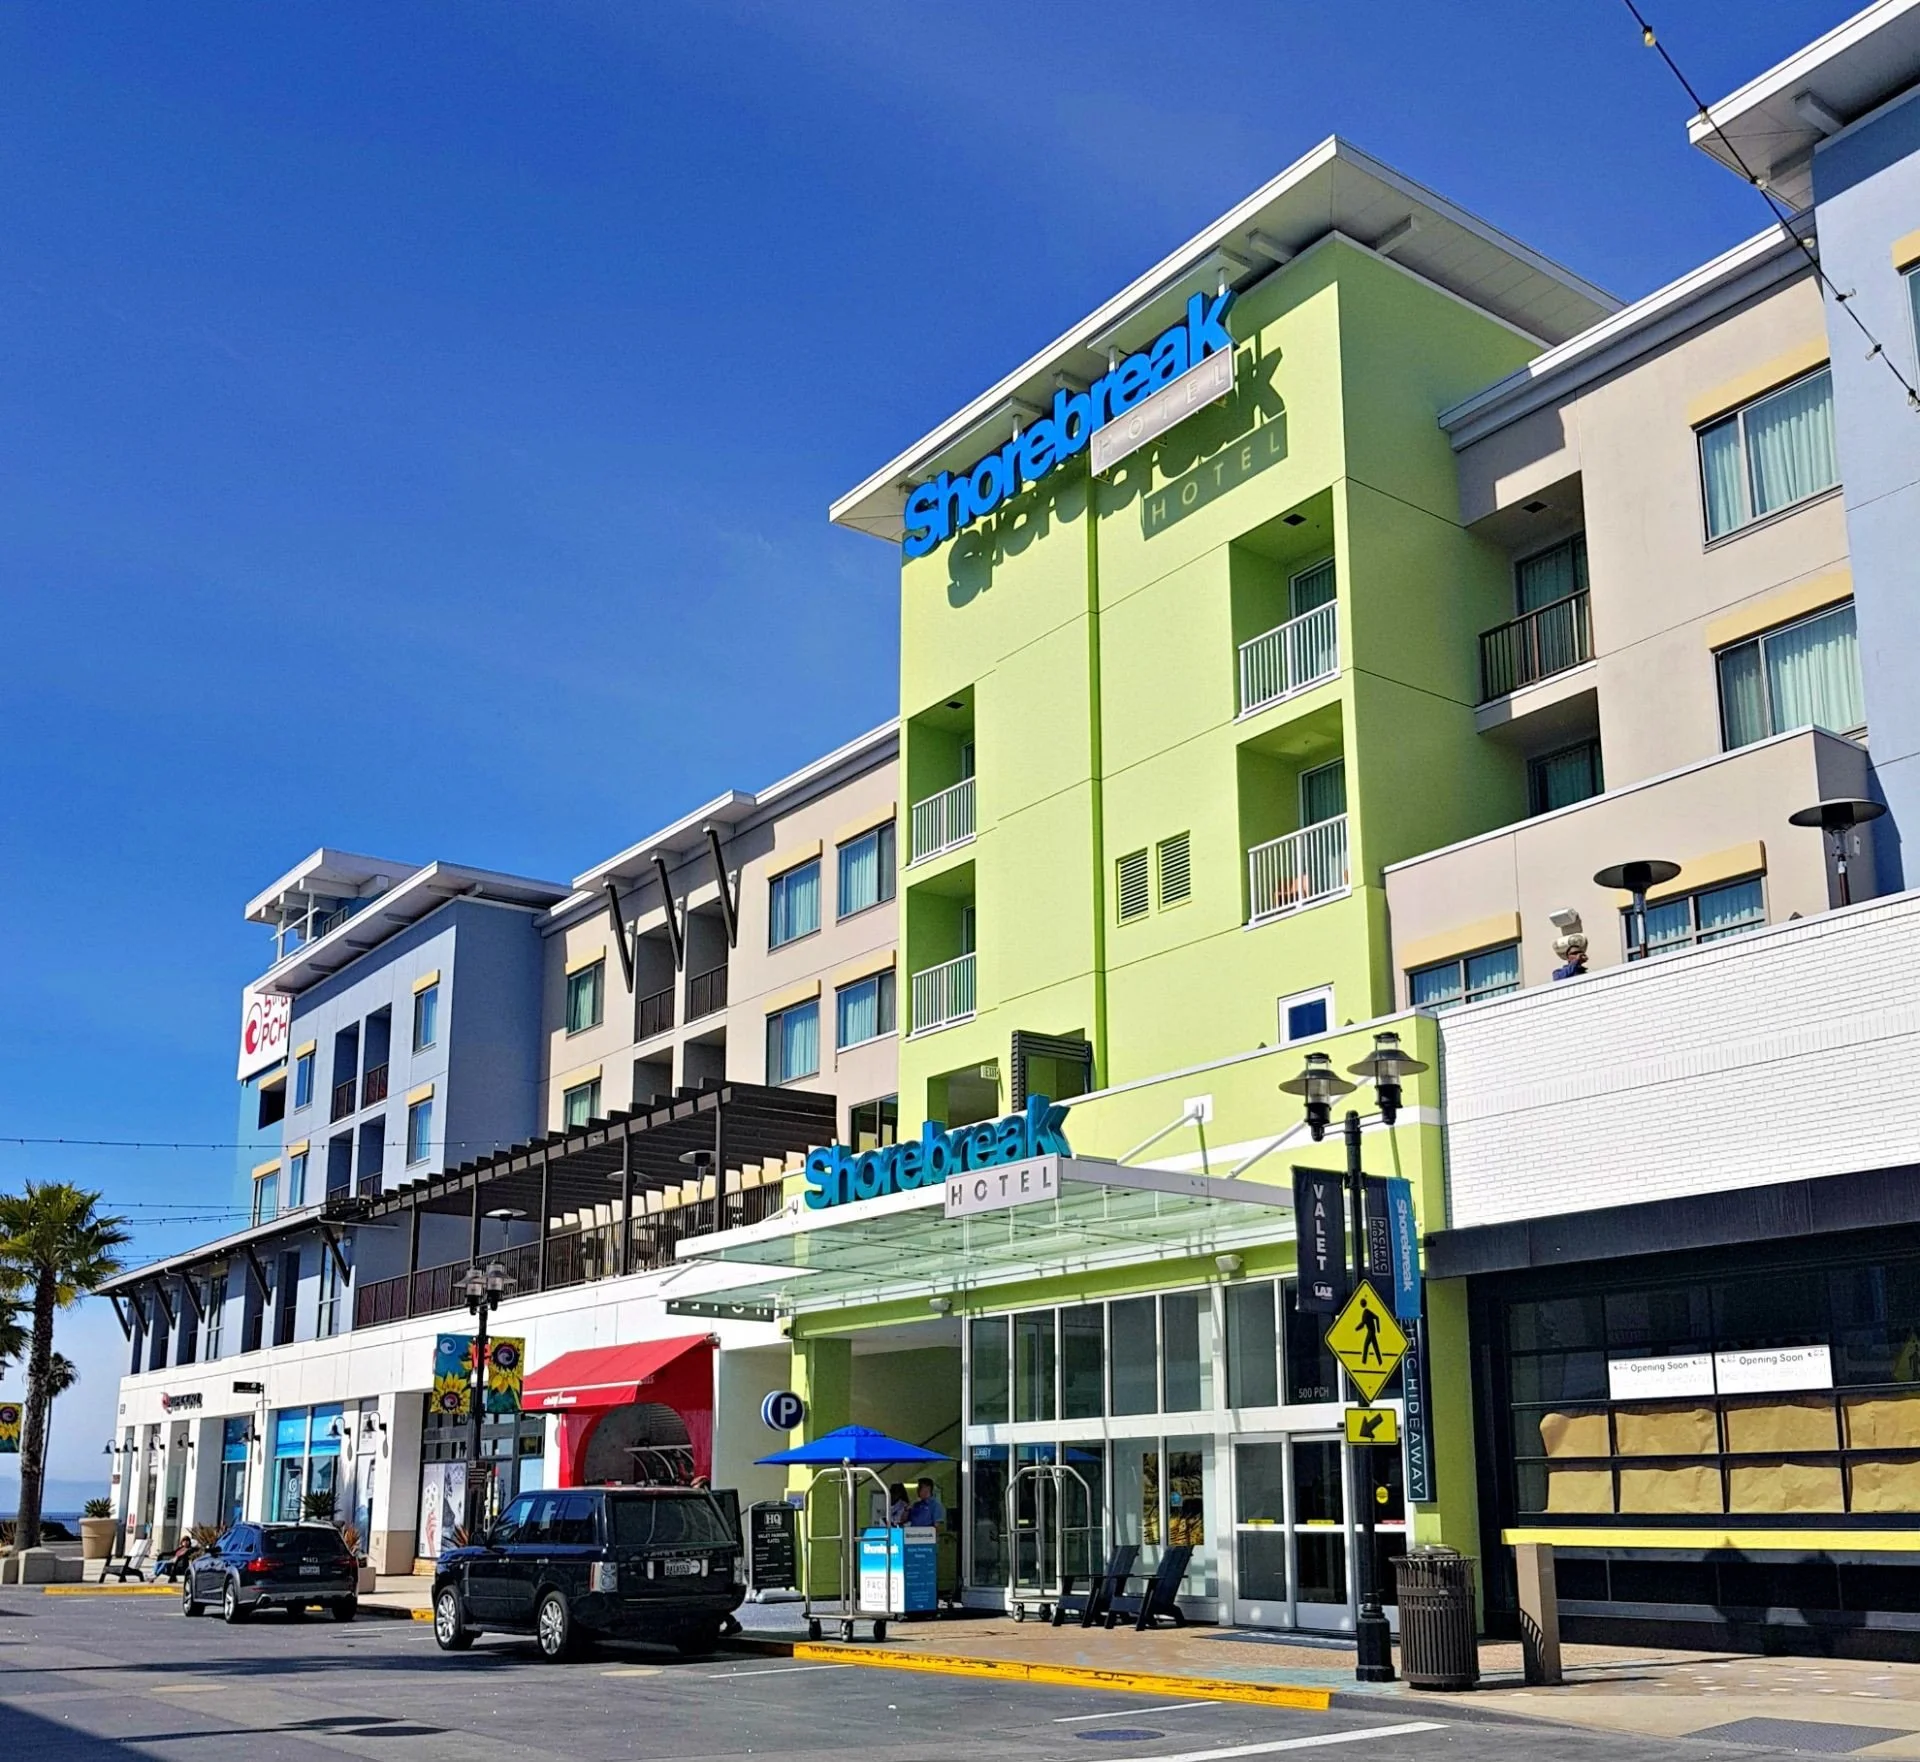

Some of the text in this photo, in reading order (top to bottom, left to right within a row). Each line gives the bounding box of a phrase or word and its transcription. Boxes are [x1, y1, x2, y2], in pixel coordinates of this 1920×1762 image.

[903, 289, 1238, 559] Shorebreak
[1097, 362, 1225, 464] HOTEL
[260, 1009, 288, 1052] PCH
[985, 1067, 996, 1078] EXIT
[804, 1094, 1072, 1209] Shorebreak
[950, 1166, 1052, 1206] HOTEL
[1313, 1184, 1328, 1271] VALET
[1371, 1220, 1381, 1271] HIDEAWAY
[1377, 1220, 1388, 1271] PACIFIC
[1314, 1285, 1333, 1297] LAZ
[1630, 1363, 1666, 1373] Opening
[1666, 1361, 1689, 1371] Soon
[1739, 1355, 1778, 1366] Opening
[1779, 1353, 1804, 1363] Soon
[780, 1397, 798, 1425] P
[1298, 1386, 1329, 1398] 500 PCH
[1407, 1378, 1424, 1493] HIDEAWAY
[765, 1513, 782, 1525] HQ
